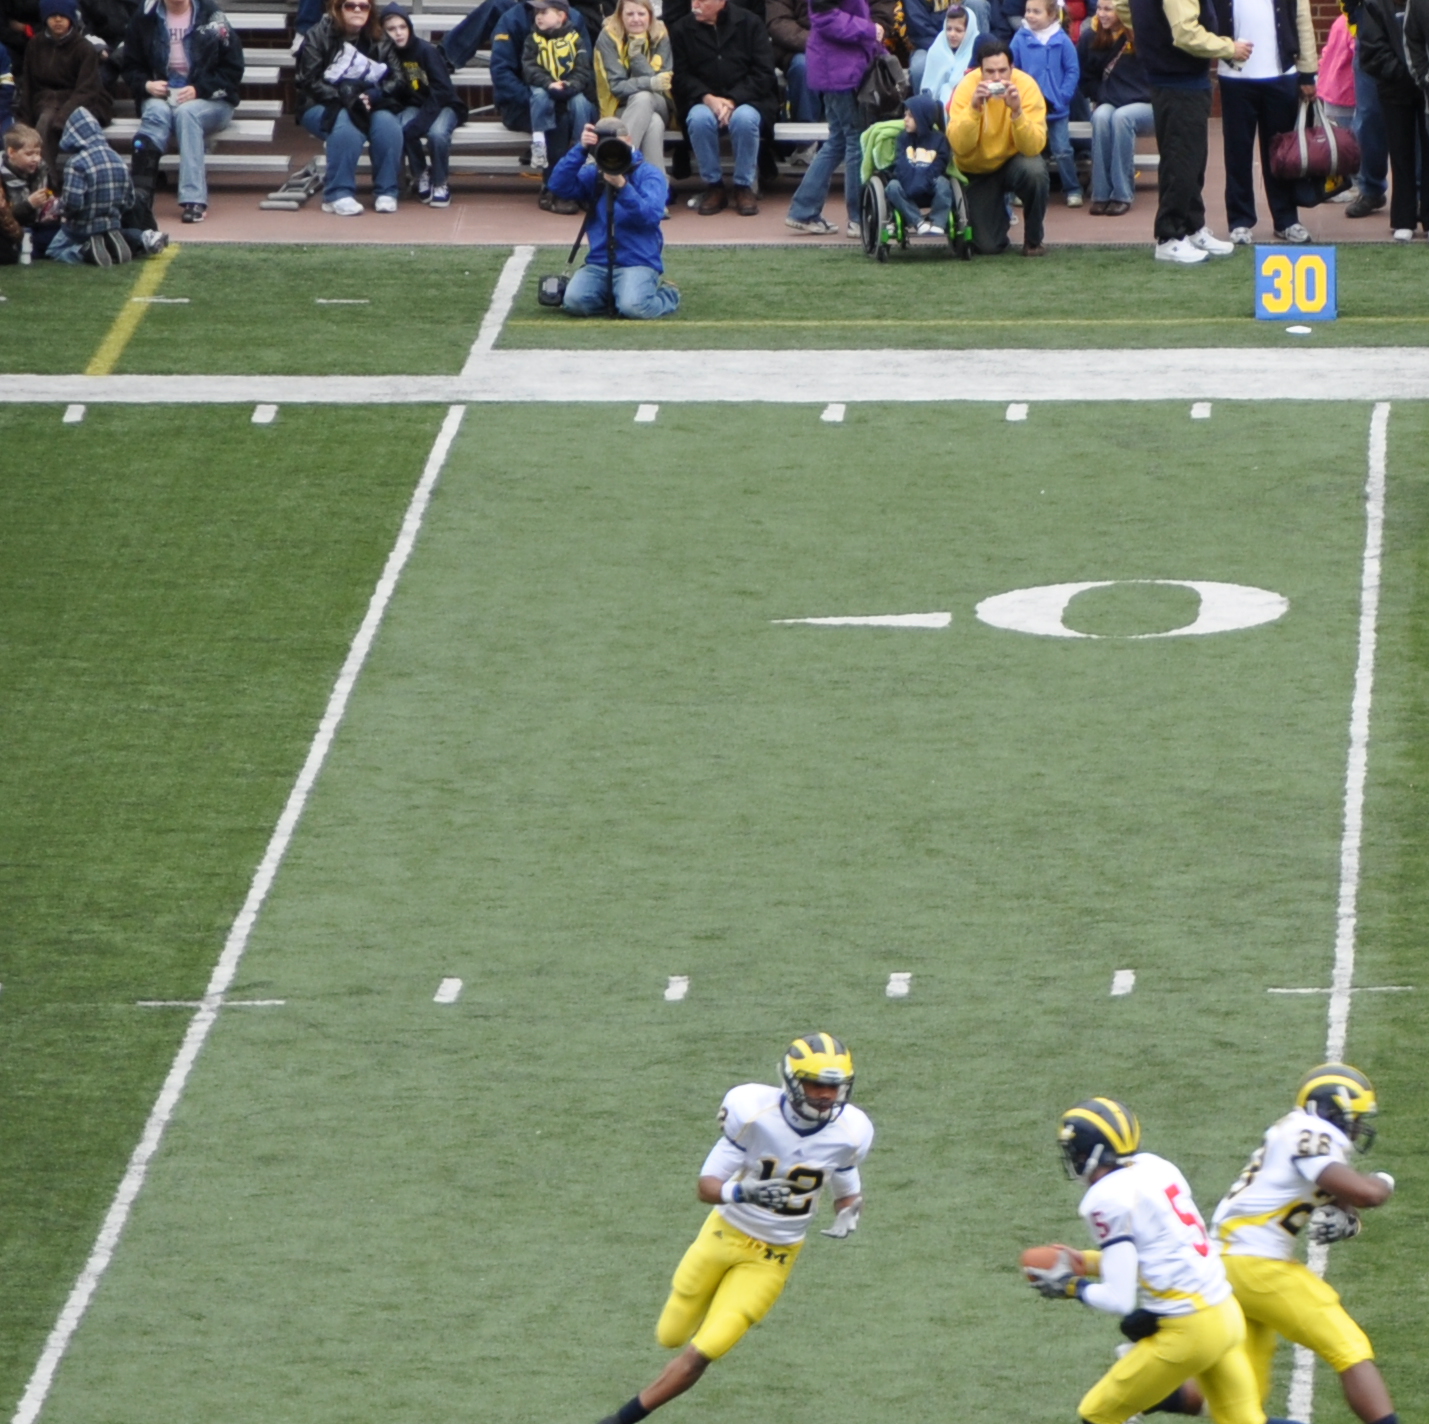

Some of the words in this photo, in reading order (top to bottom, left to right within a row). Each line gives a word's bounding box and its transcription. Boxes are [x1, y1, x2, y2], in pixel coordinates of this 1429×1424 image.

[1261, 255, 1328, 313] 30
[1090, 1210, 1111, 1239] 5
[1164, 1184, 1209, 1258] 5
